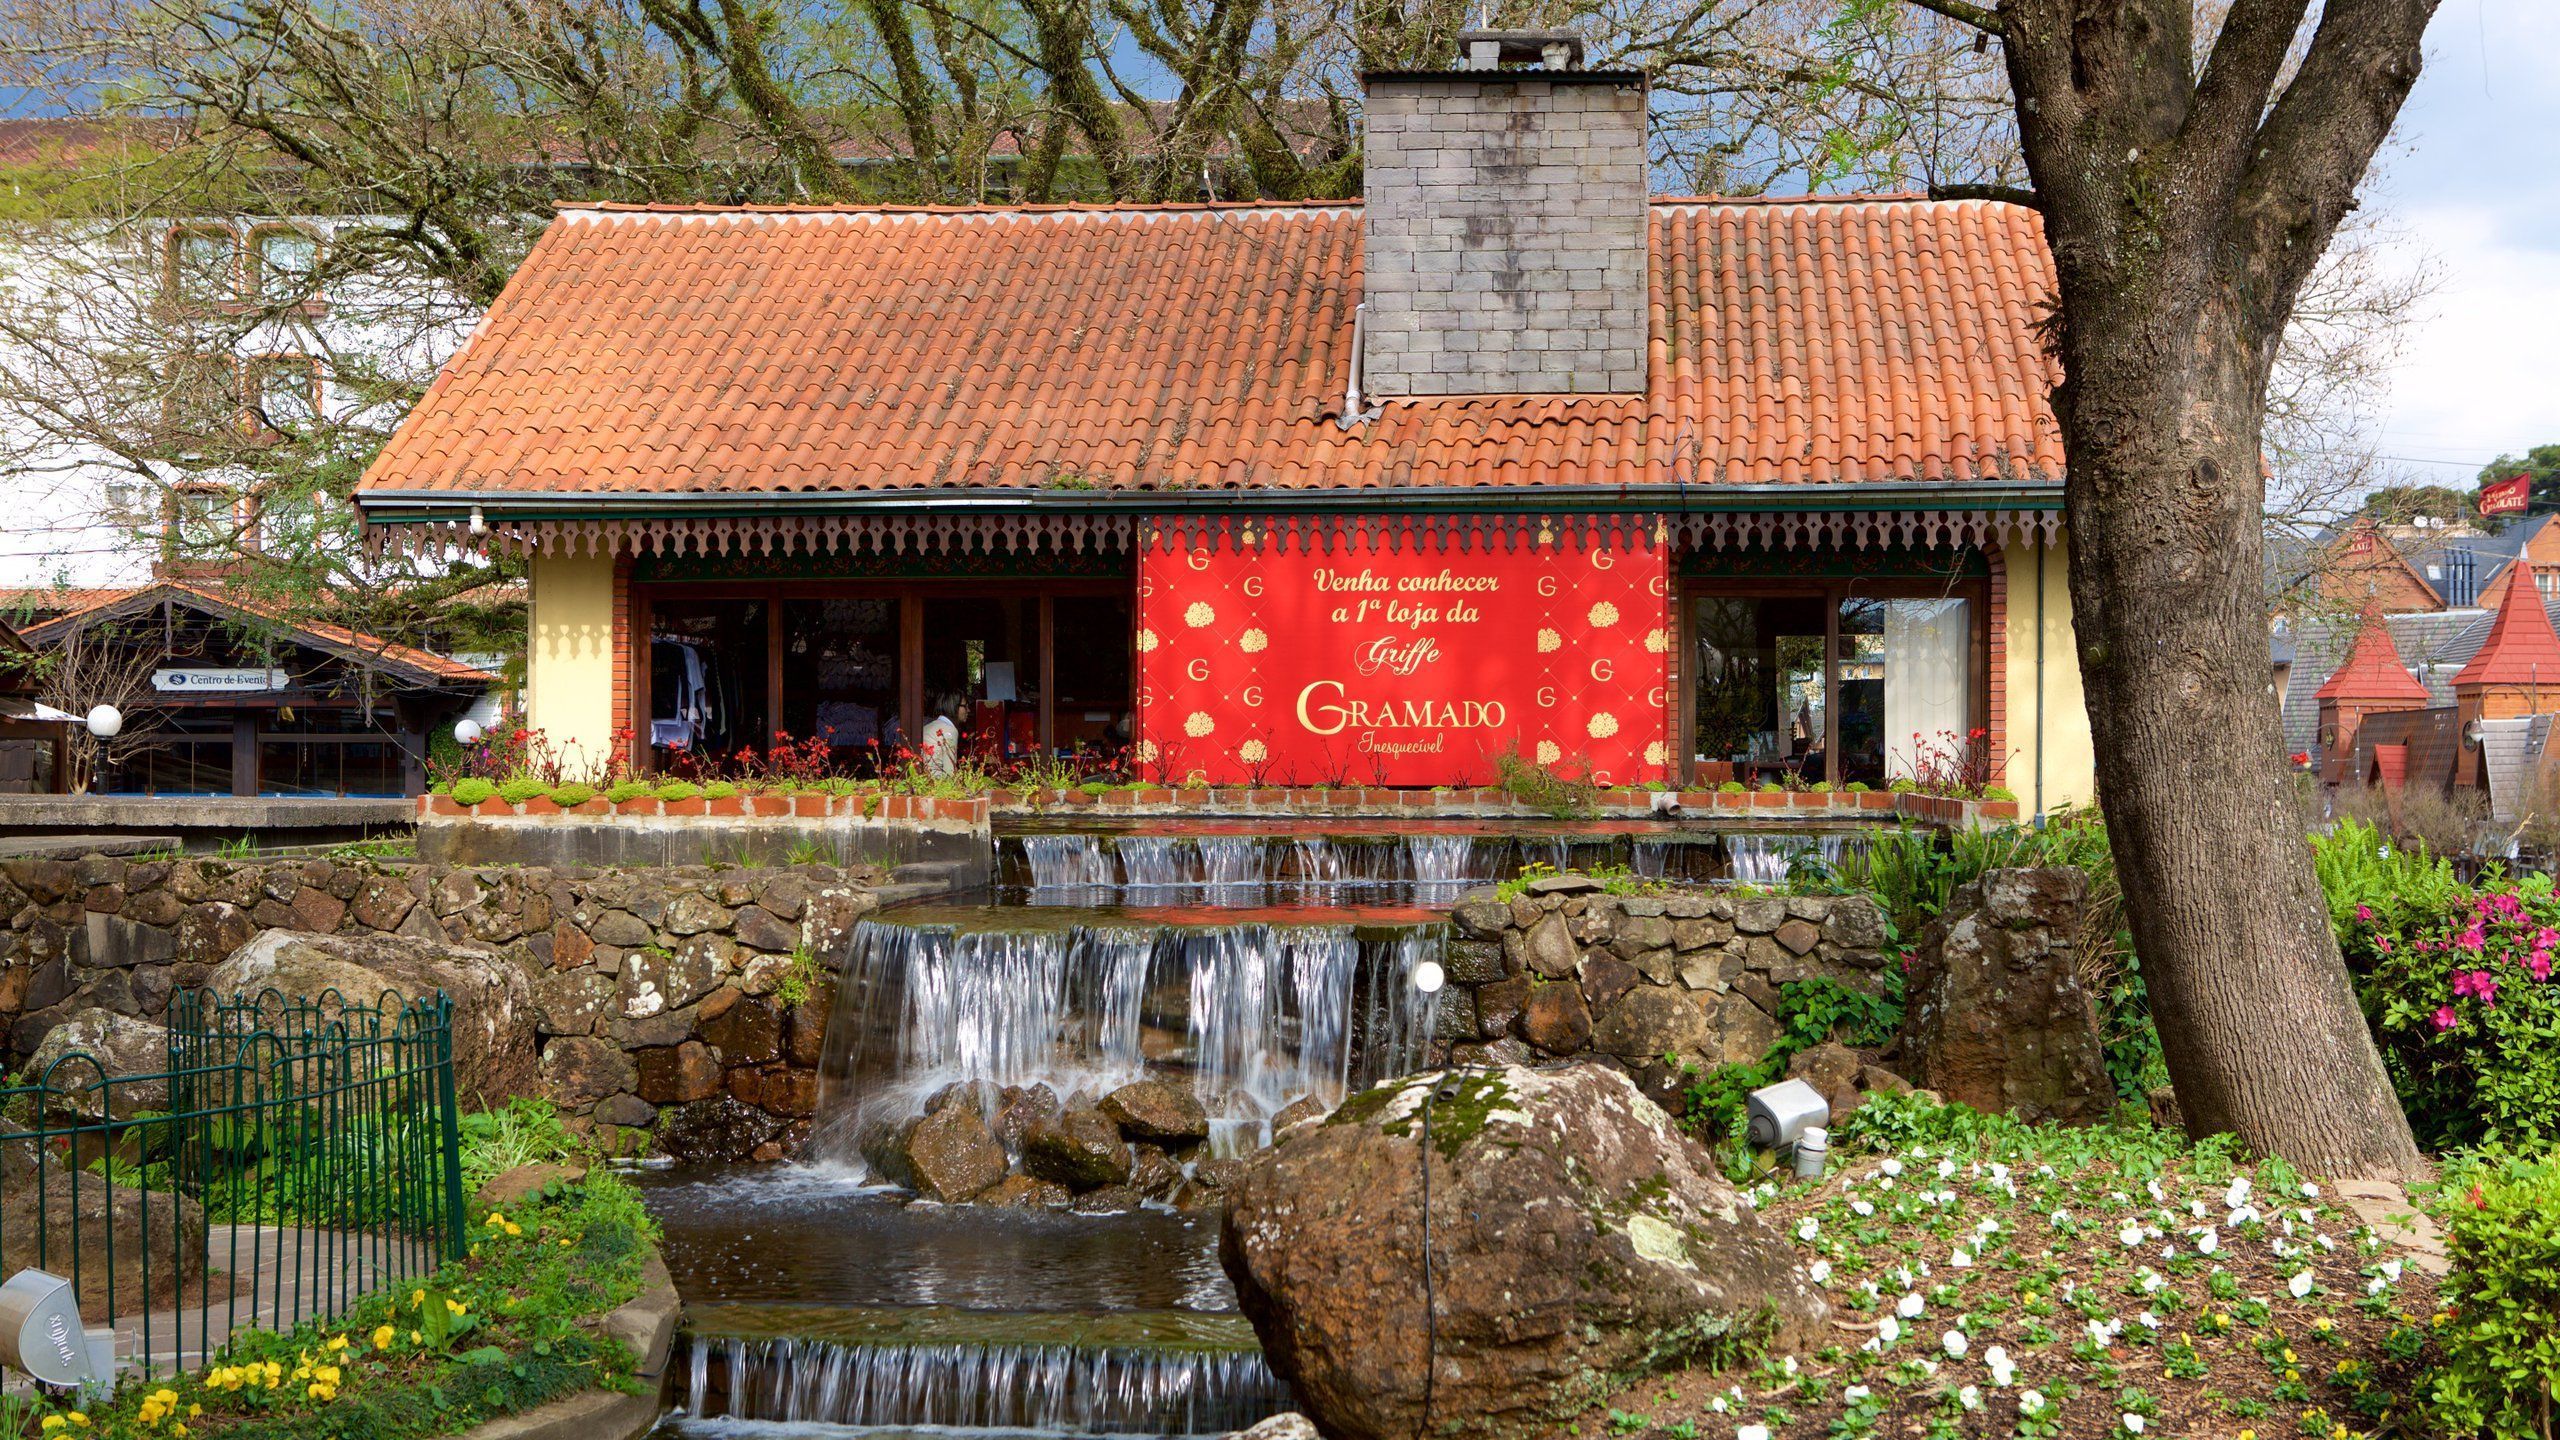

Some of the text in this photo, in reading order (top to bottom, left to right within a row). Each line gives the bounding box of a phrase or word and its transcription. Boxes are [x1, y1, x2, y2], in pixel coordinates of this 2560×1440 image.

[1187, 547, 1211, 571] G
[1591, 547, 1615, 570] G
[1243, 576, 1264, 597] G
[1313, 568, 1500, 592] Venha conhecer
[1537, 576, 1557, 597] G
[1331, 606, 1349, 623] a
[1386, 599, 1440, 630] loja
[1446, 599, 1480, 623] da
[1354, 635, 1442, 677] Griffe
[191, 674, 267, 684] Centro de Evento
[1187, 658, 1211, 682] G
[1590, 658, 1615, 682] G
[1243, 686, 1264, 707] G
[1296, 680, 1506, 735] GRAMADO
[1537, 686, 1557, 707] G
[1357, 730, 1444, 760] Inesquecível
